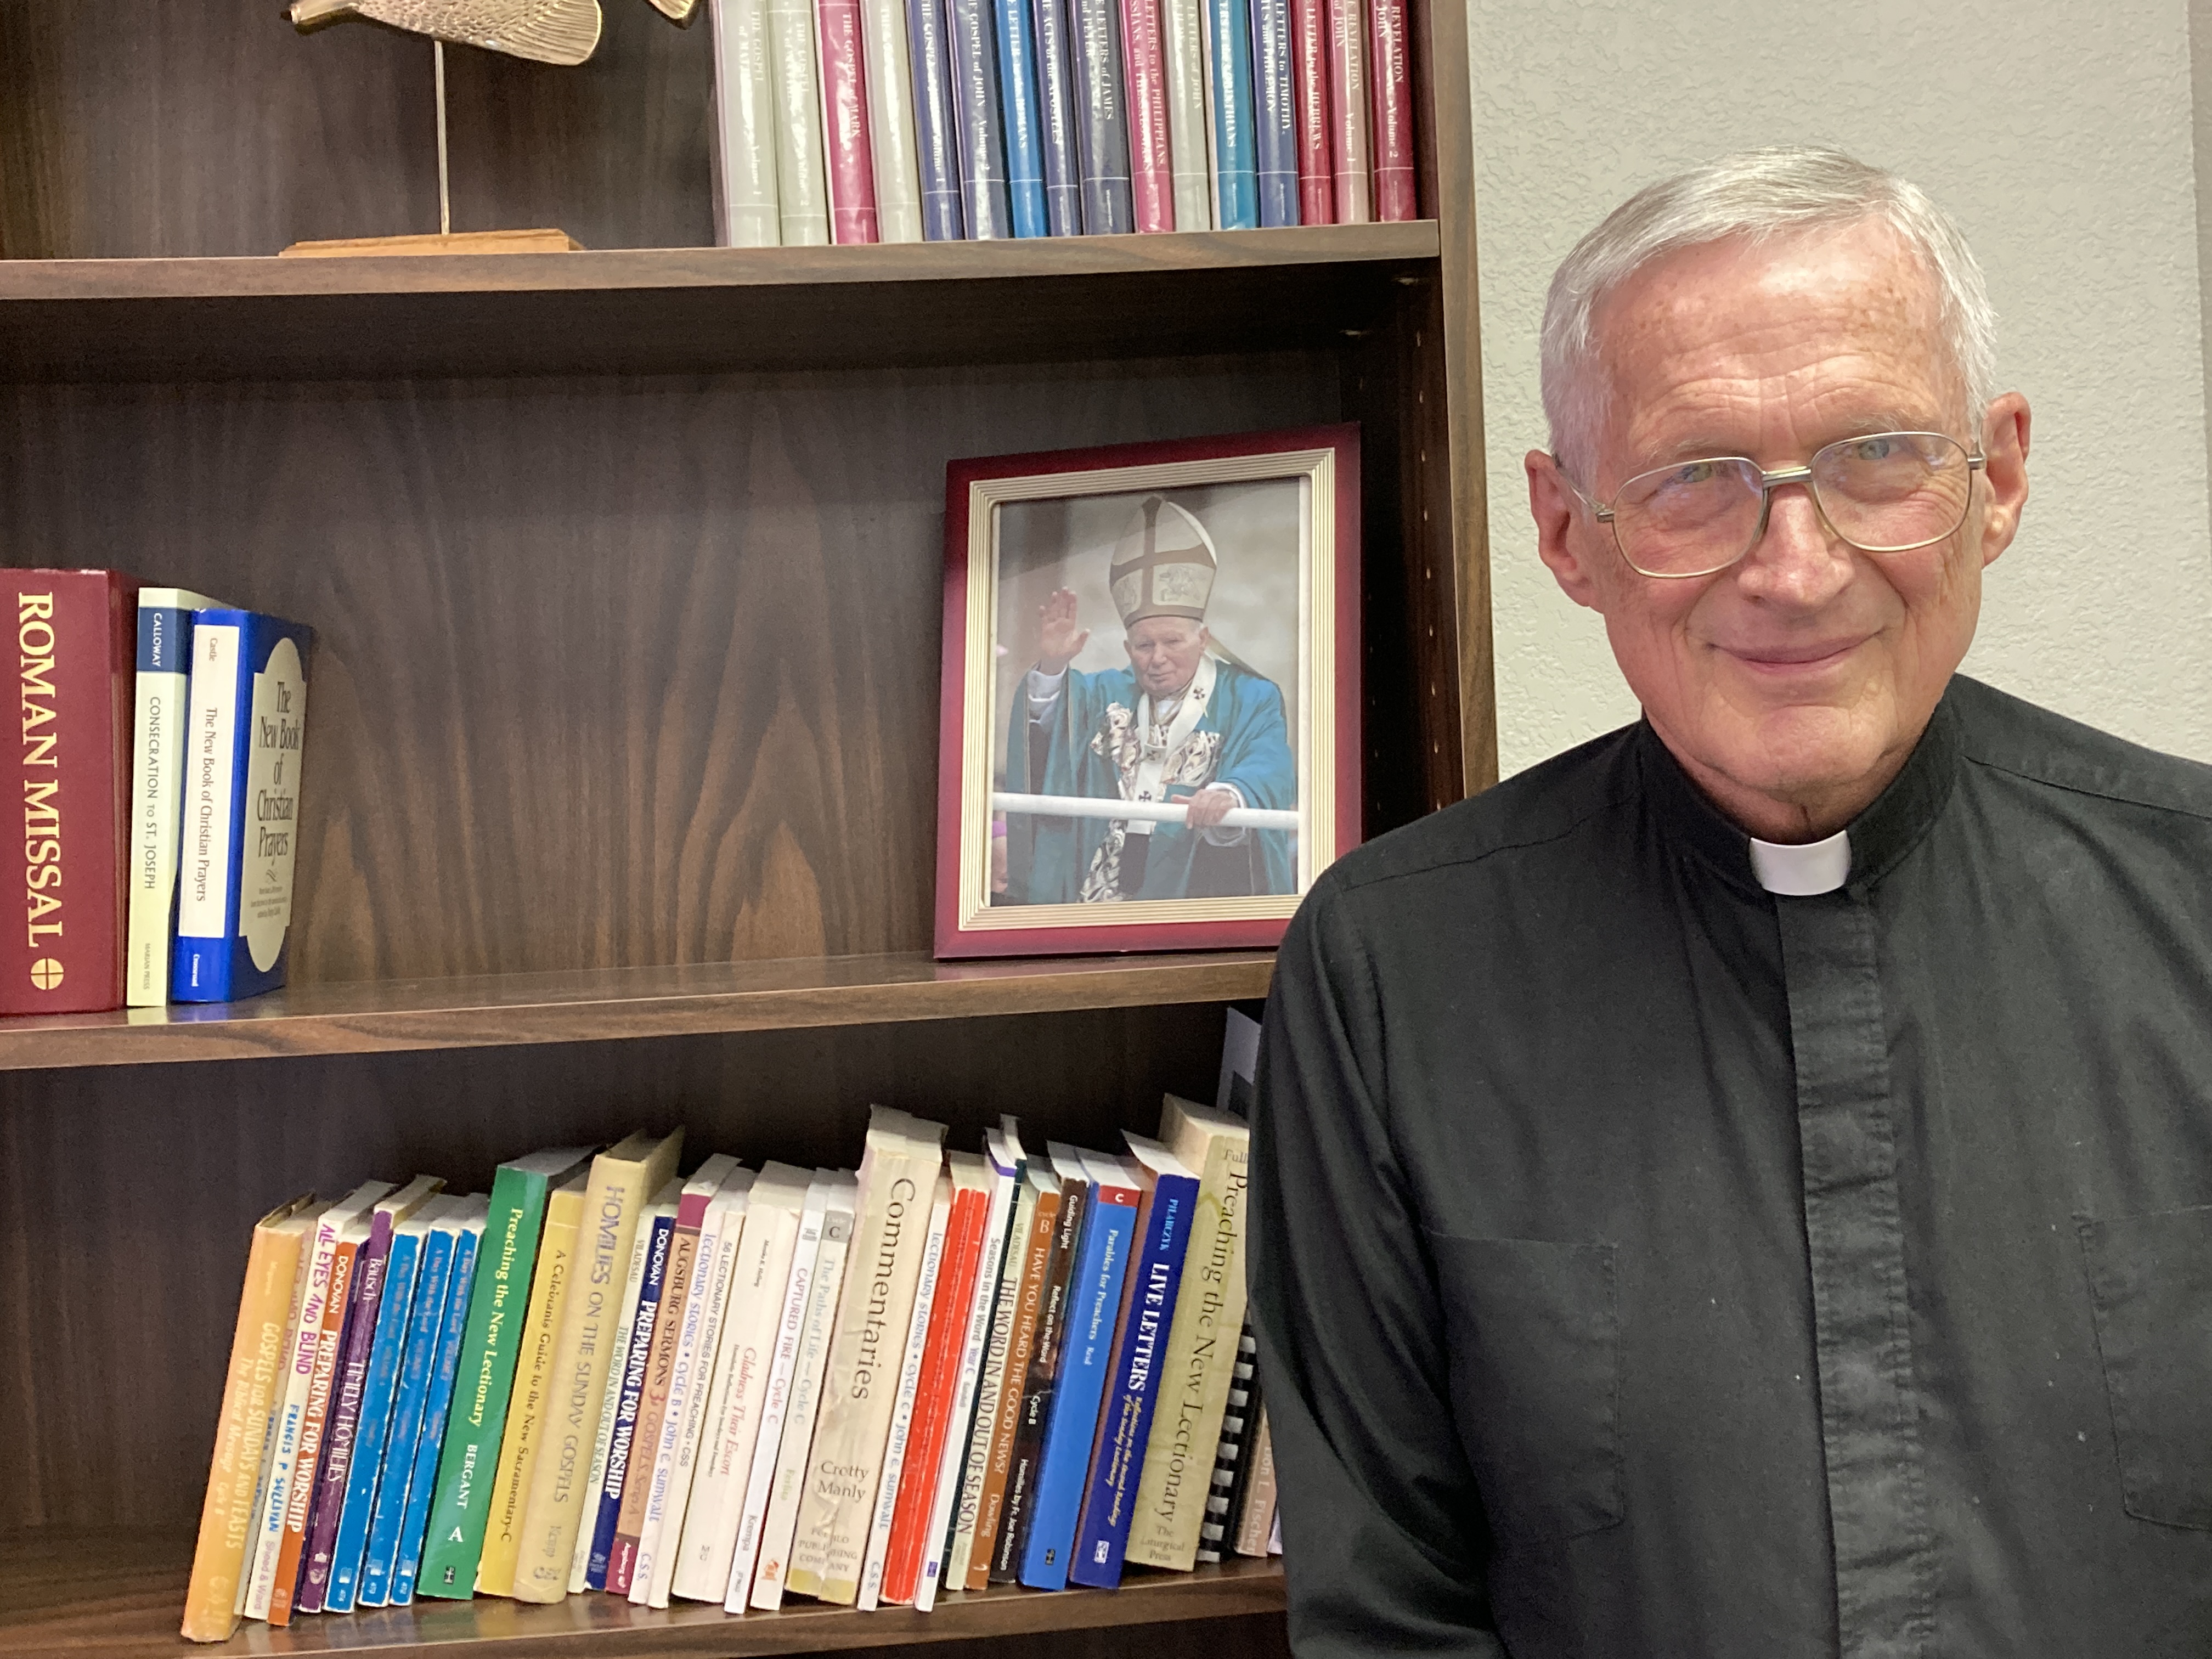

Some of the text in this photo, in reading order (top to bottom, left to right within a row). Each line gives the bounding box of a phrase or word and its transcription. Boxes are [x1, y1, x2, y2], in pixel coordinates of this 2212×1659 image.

[843, 13, 853, 36] THE
[1096, 10, 1108, 63] LETTERS
[1274, 3, 1286, 57] LETTERS
[1375, 5, 1389, 37] JOHN
[844, 40, 856, 84] GOSPEL
[1149, 54, 1158, 64] to
[1347, 13, 1359, 90] REVELATION
[1390, 5, 1404, 82] REVELATION
[1101, 66, 1110, 78] of
[1149, 68, 1159, 84] the
[1278, 60, 1286, 70] to
[1101, 81, 1113, 120] JAMES
[848, 104, 861, 137] MARK
[1344, 112, 1356, 153] Volume
[1386, 105, 1398, 146] Volume
[151, 613, 162, 667] CALLOWAY
[208, 637, 218, 662] Castle
[276, 681, 291, 713] The
[146, 696, 161, 798] CONSECRATION
[259, 716, 301, 750] New Book
[17, 591, 63, 947] ROMAN MISSAL
[273, 753, 284, 785] of
[193, 707, 218, 901] The New Book of Christian Prayers
[257, 788, 293, 821] Christian
[145, 822, 157, 840] ST.
[258, 826, 289, 866] Prayers
[143, 844, 156, 889] JOSEPH
[190, 953, 200, 987] Crossroad
[1062, 1194, 1078, 1227] Guiding
[1113, 1192, 1125, 1203] C
[827, 1225, 841, 1239] C
[1039, 1220, 1051, 1234] B
[1058, 1227, 1072, 1250] Light
[1159, 1198, 1179, 1252] PILARCZYK
[983, 1236, 1001, 1279] Seasons
[1007, 1221, 1024, 1268] VILADESAU
[361, 1257, 382, 1302] Bausch
[849, 1176, 918, 1403] Commentaries
[981, 1280, 992, 1292] in
[997, 1276, 1018, 1307] THE
[1082, 1228, 1119, 1365] Parables for Preachers Reid
[466, 1206, 523, 1427] Preaching the New Lectionary
[977, 1294, 990, 1311] the
[1047, 1284, 1062, 1314] Reflect
[971, 1313, 986, 1342] Word
[988, 1308, 1012, 1358] WORD
[1042, 1325, 1053, 1341] the
[1045, 1313, 1054, 1326] on
[1126, 1261, 1170, 1392] LIVE LETTERS
[552, 1184, 626, 1504] HOMILIES ON THE SUNDAY GOSPELS
[679, 1240, 732, 1468] 56 LECTIONARY STORIES FOR PREACHING CSS
[767, 1267, 808, 1424] CAPTURED FIRE Cycle C
[794, 1258, 834, 1425] The Paths of Life Cycle C
[966, 1346, 980, 1367] Year
[1038, 1340, 1051, 1363] Word
[1152, 1169, 1248, 1525] Preaching the New Lectionary
[588, 1238, 645, 1485] VILADESAU THE WORD IN AND OUT OF SEASON
[603, 1227, 669, 1500] DONOVAN PREPARING FOR WORSHIP
[964, 1367, 976, 1375] C
[985, 1359, 1002, 1377] IN
[285, 1254, 349, 1534] DONOVAN PREPARING FOR WORSHIP
[340, 1361, 364, 1412] TIMELY
[977, 1378, 999, 1414] AND
[980, 1246, 1046, 1538] HAVE YOU HEARD THE GOOD NEWS? Dowling
[719, 1346, 758, 1476] Gladness Their Escort
[1026, 1394, 1041, 1418] Cycle
[280, 1404, 300, 1454] FRANCIS
[970, 1414, 992, 1451] OUT
[456, 1443, 478, 1509] BERGANT
[821, 1460, 870, 1482] Crotty
[967, 1449, 986, 1472] OF
[1013, 1458, 1029, 1495] Homilies
[264, 1476, 287, 1532] SULLIVAN
[817, 1480, 866, 1503] Manly
[955, 1472, 982, 1535] SEASON
[1011, 1493, 1022, 1505] by
[447, 1525, 466, 1543] A
[740, 1513, 758, 1553] Krempa
[1006, 1516, 1017, 1532] Joe
[1156, 1525, 1175, 1537] The
[998, 1531, 1015, 1571] Robinson
